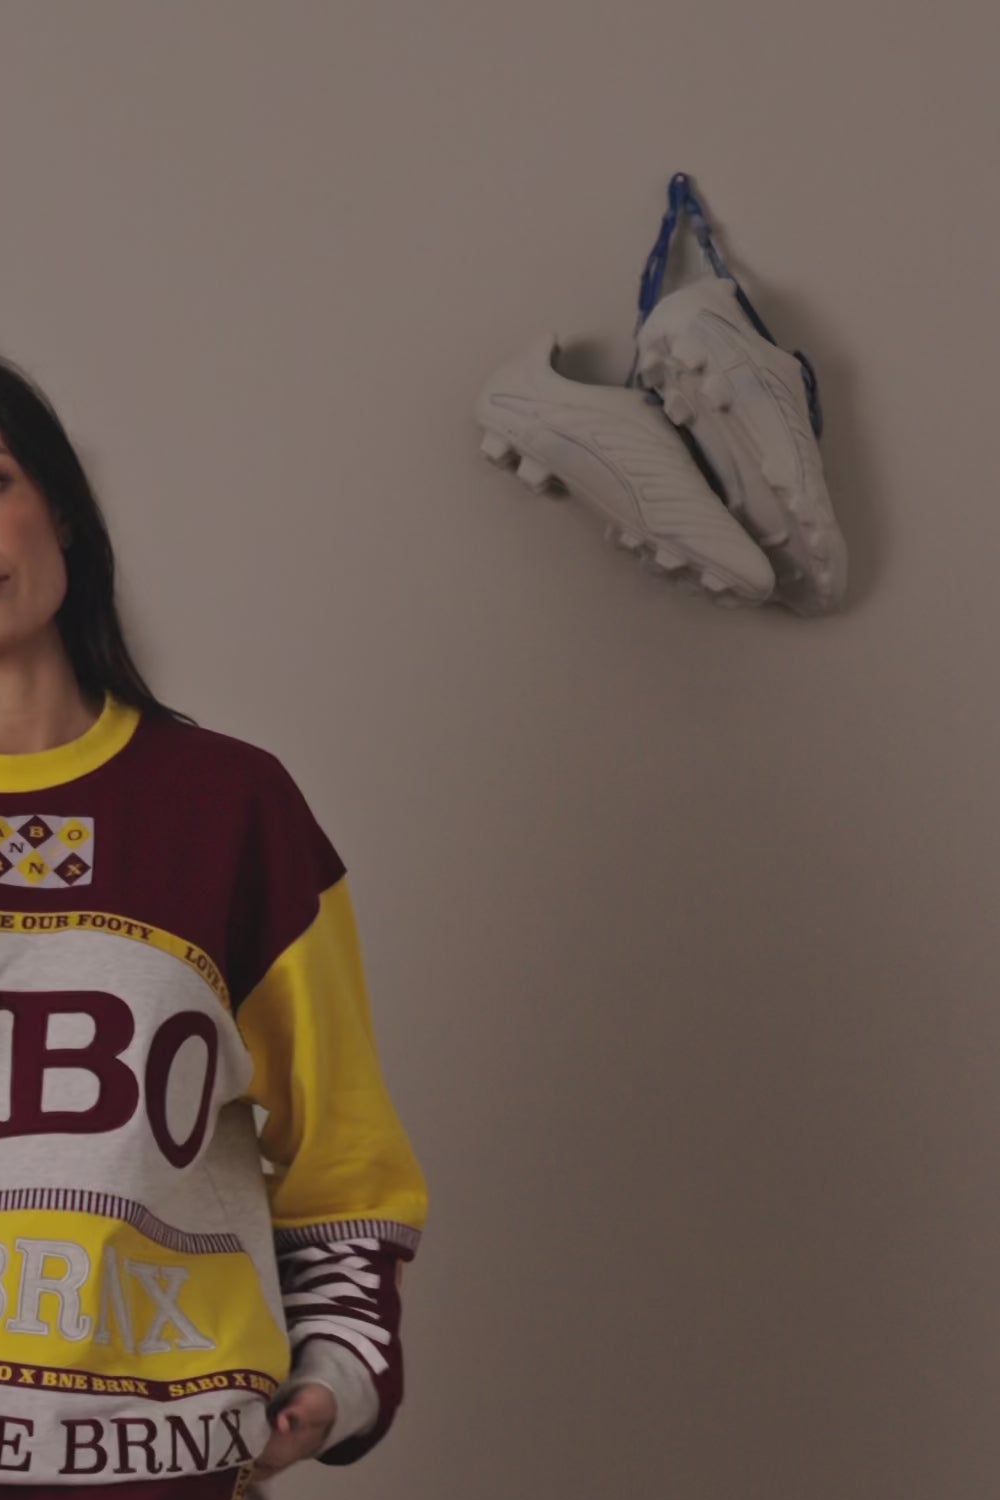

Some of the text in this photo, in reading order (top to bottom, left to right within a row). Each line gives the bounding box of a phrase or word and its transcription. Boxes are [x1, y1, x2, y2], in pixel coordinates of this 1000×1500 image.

[21, 914, 69, 930] OUR
[76, 914, 153, 940] FOOTY
[18, 1369, 35, 1385] X
[42, 1370, 88, 1390] BNE
[91, 1377, 149, 1396] BRNX
[168, 1373, 228, 1398] SABO
[232, 1373, 247, 1387] X
[58, 1409, 254, 1475] BRNX
